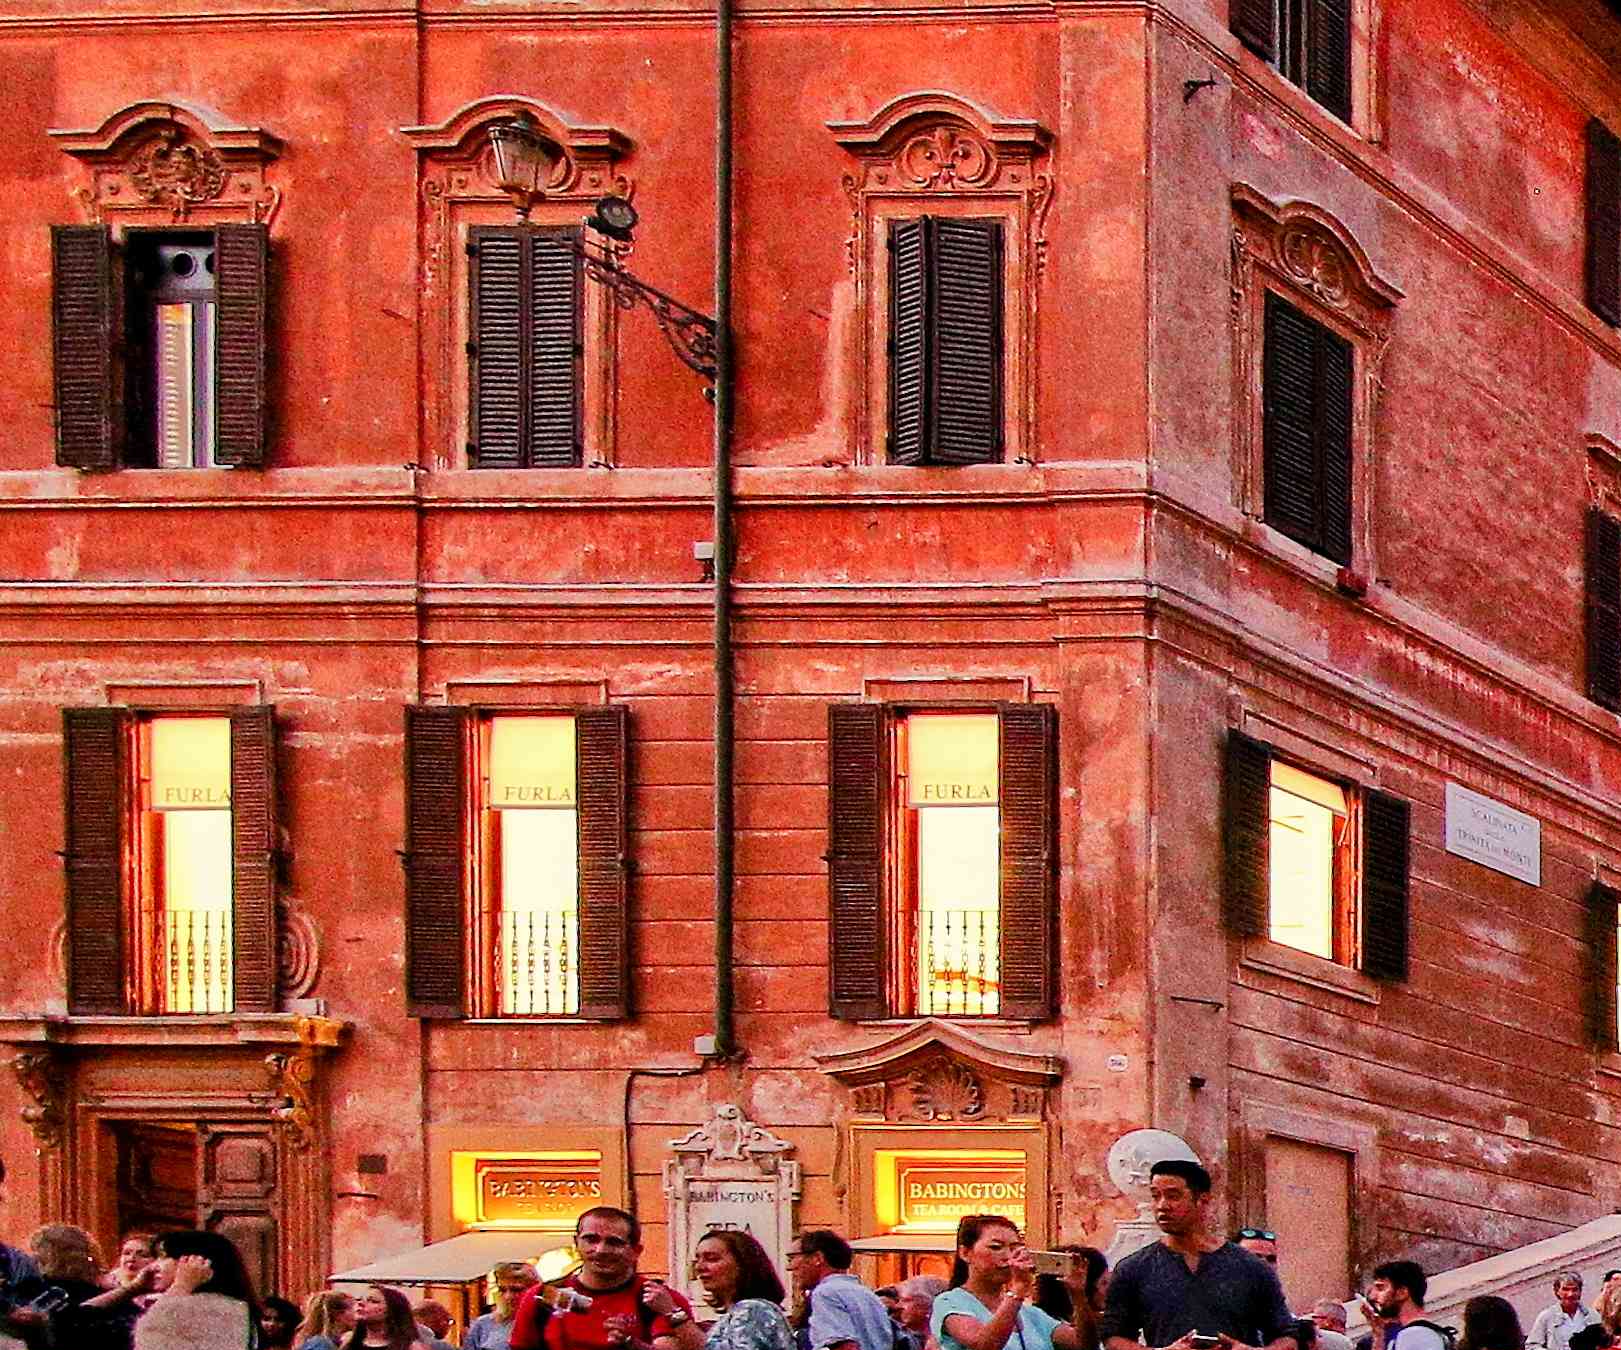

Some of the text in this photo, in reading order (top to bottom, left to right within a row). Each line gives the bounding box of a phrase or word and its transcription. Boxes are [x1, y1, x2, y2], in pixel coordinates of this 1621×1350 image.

[165, 787, 231, 802] FURLA
[504, 786, 571, 801] FURLA
[924, 784, 992, 799] FURLA
